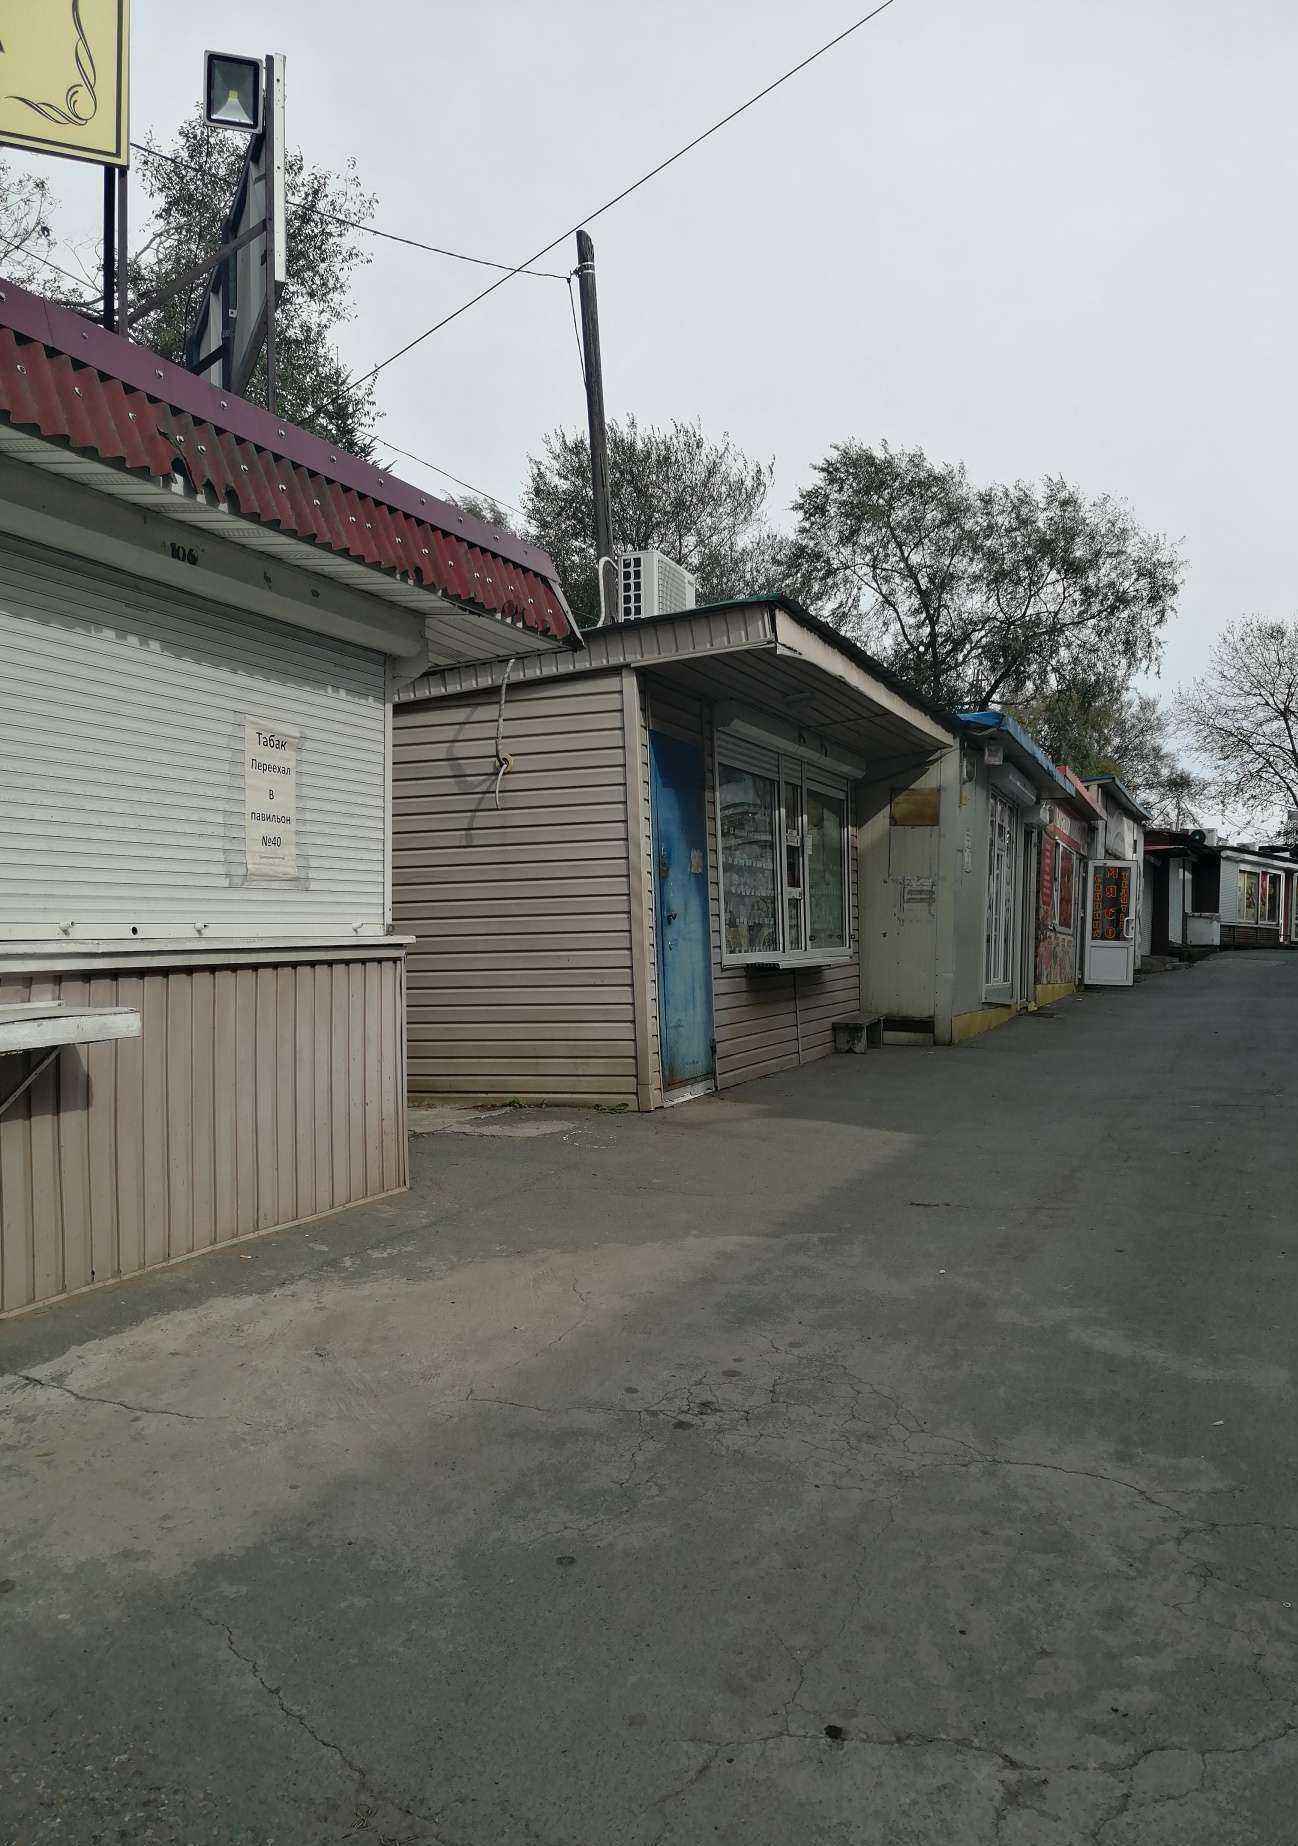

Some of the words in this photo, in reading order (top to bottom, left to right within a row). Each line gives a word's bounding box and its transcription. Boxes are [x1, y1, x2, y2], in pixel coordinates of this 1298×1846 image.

[255, 731, 288, 751] Табак
[250, 758, 291, 776] Переехал
[250, 811, 291, 824] павильон
[261, 835, 282, 848] №40
